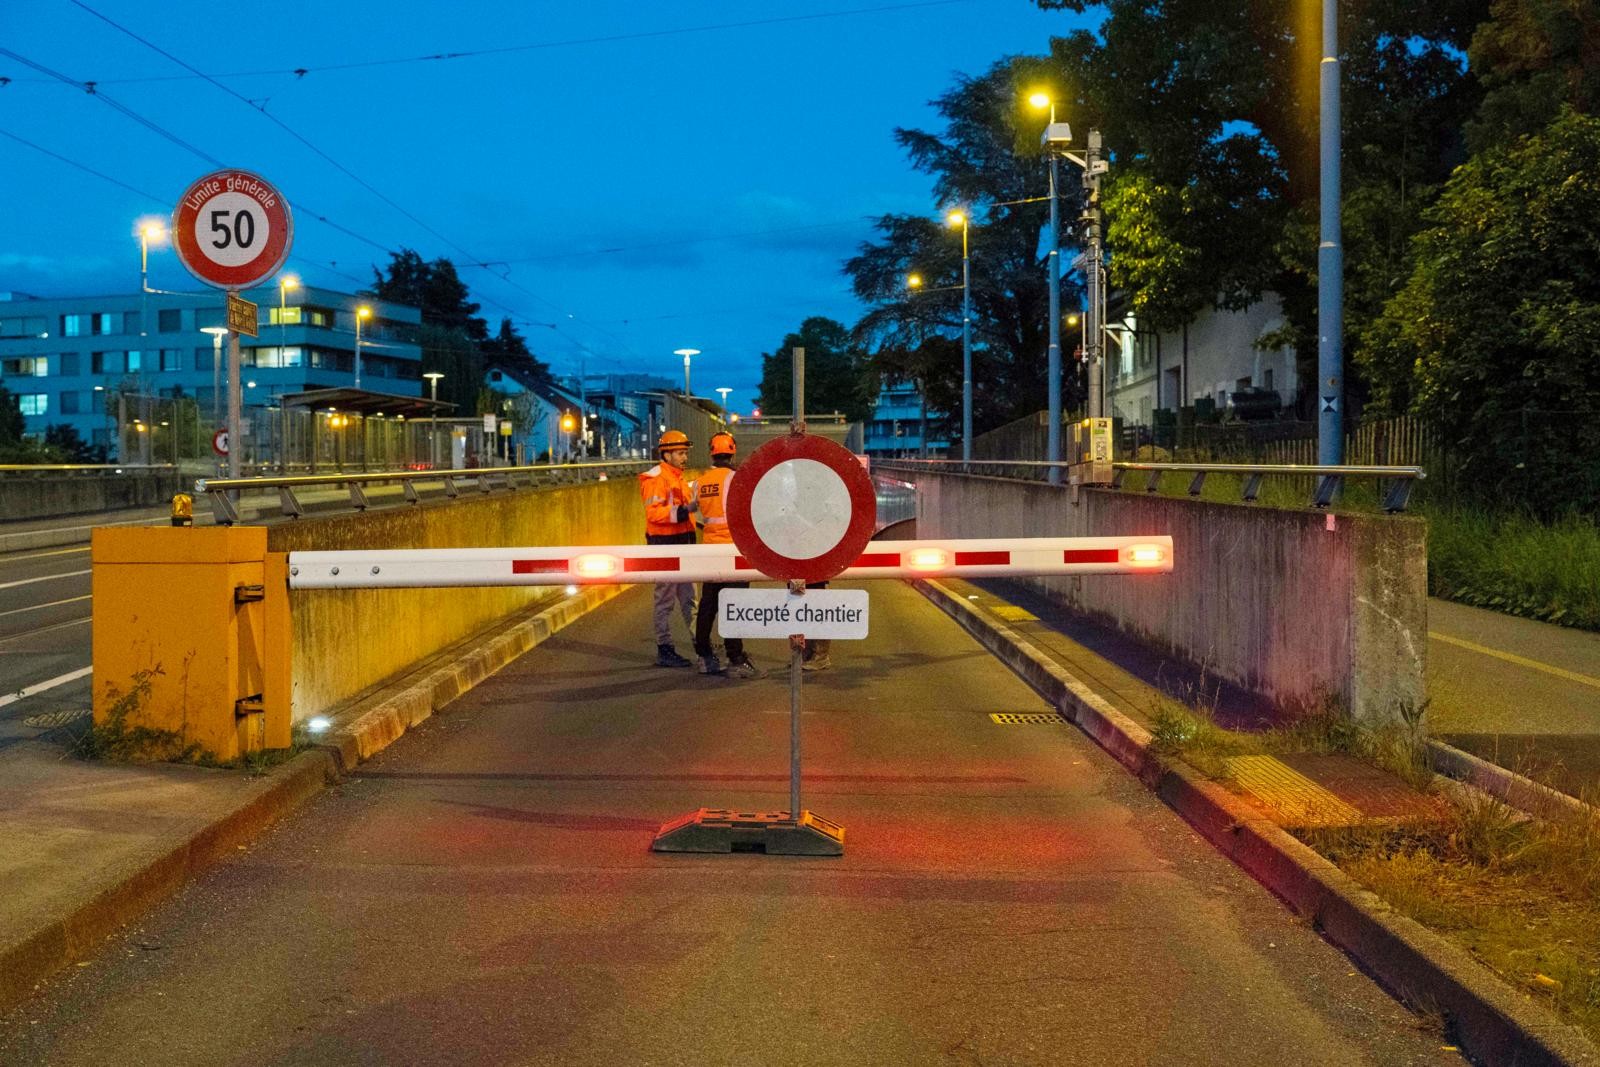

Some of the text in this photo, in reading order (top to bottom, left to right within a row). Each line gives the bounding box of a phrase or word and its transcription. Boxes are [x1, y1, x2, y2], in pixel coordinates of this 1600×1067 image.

[185, 175, 275, 211] Limite générale
[211, 209, 255, 249] 50
[700, 484, 720, 494] GTS
[726, 603, 862, 626] Excepté chantier
